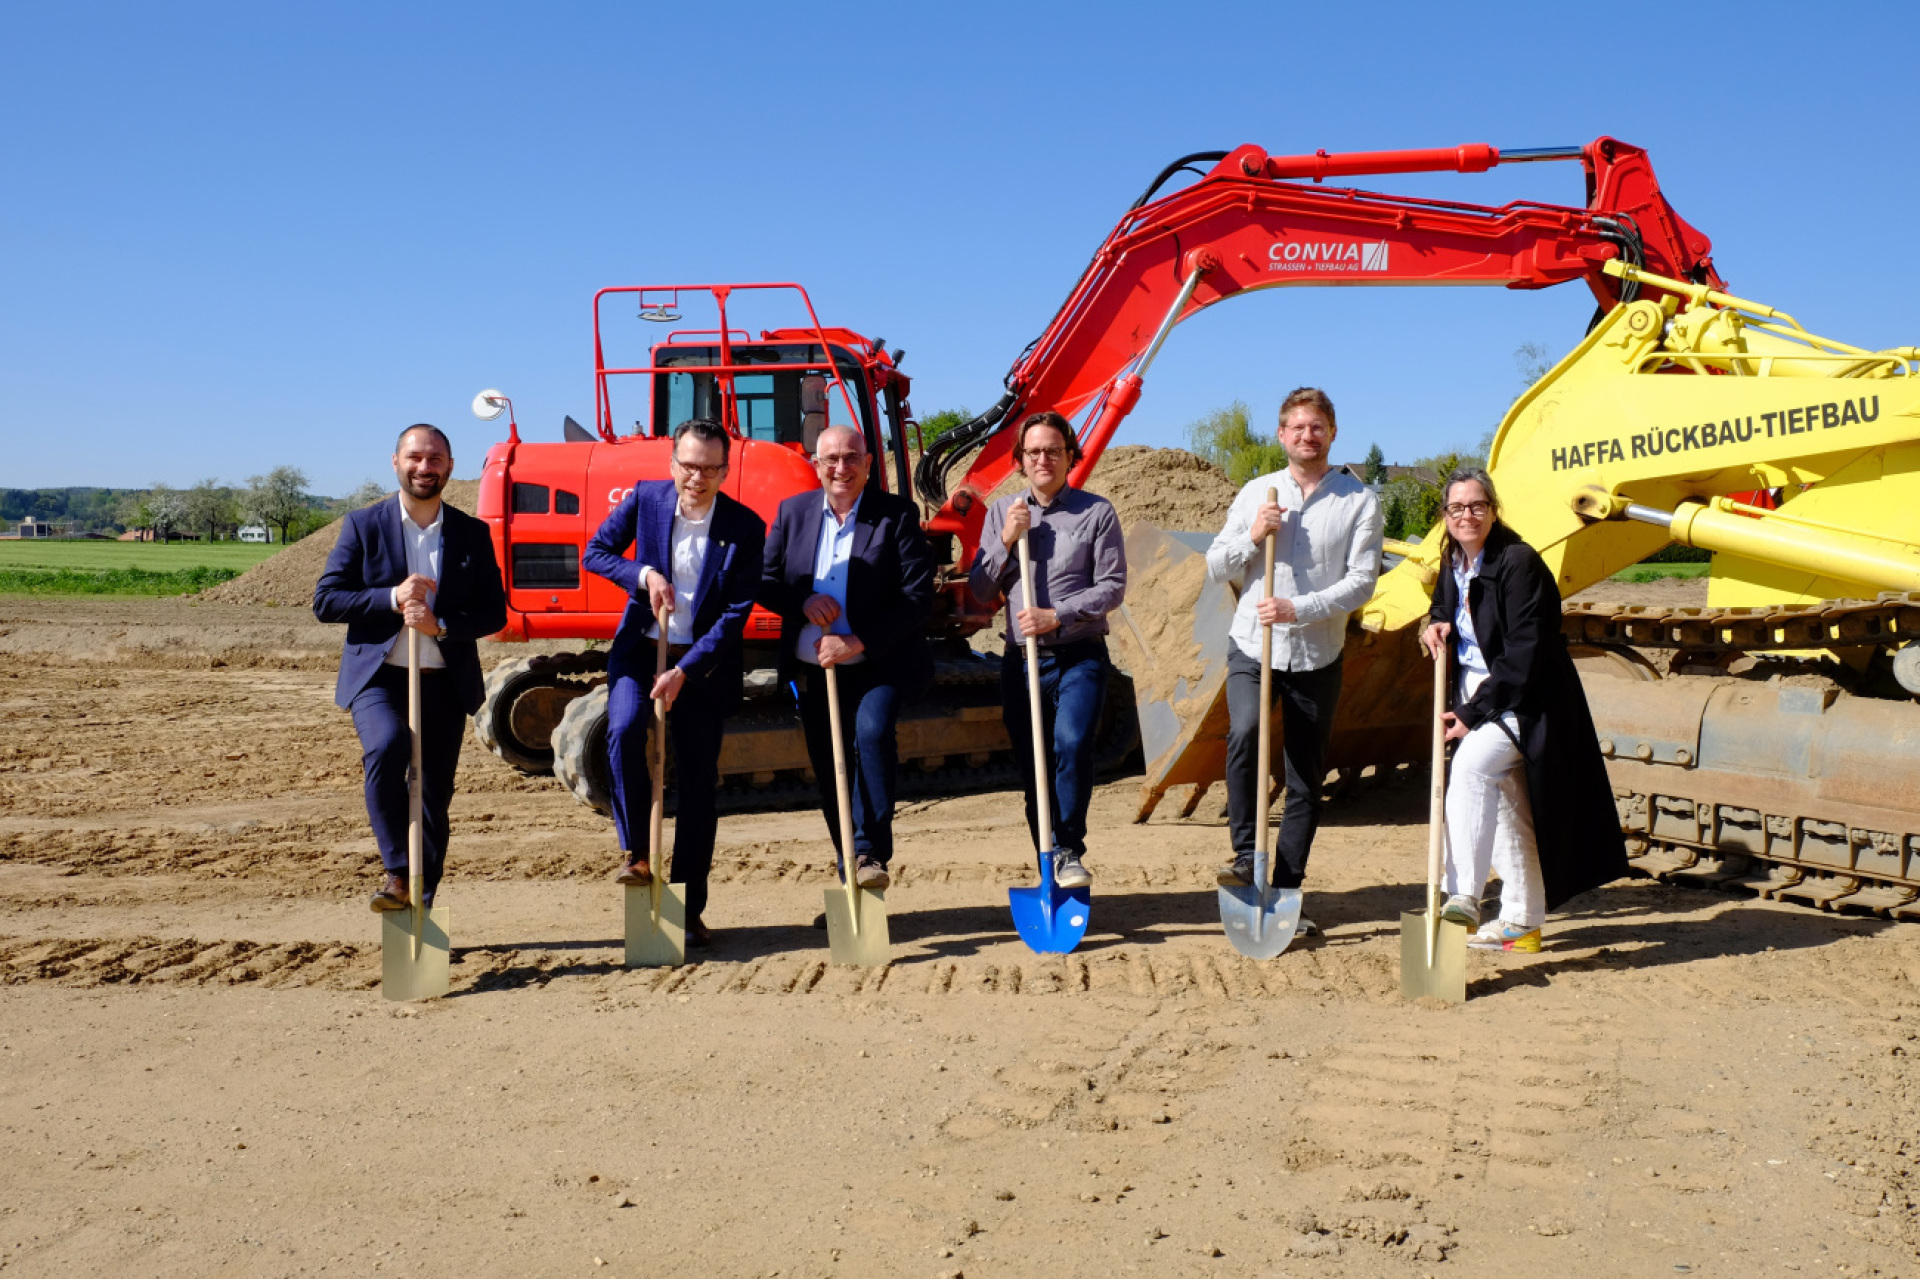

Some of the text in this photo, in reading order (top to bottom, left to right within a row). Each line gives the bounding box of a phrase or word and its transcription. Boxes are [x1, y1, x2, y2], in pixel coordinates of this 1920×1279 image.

[1268, 243, 1359, 261] CONVIA
[1268, 263, 1306, 271] STRASSEN
[1315, 263, 1345, 271] TIEFBAU
[1347, 263, 1359, 271] AG
[1551, 395, 1880, 472] HAFFA RÜCKBAU-TIEFBAU
